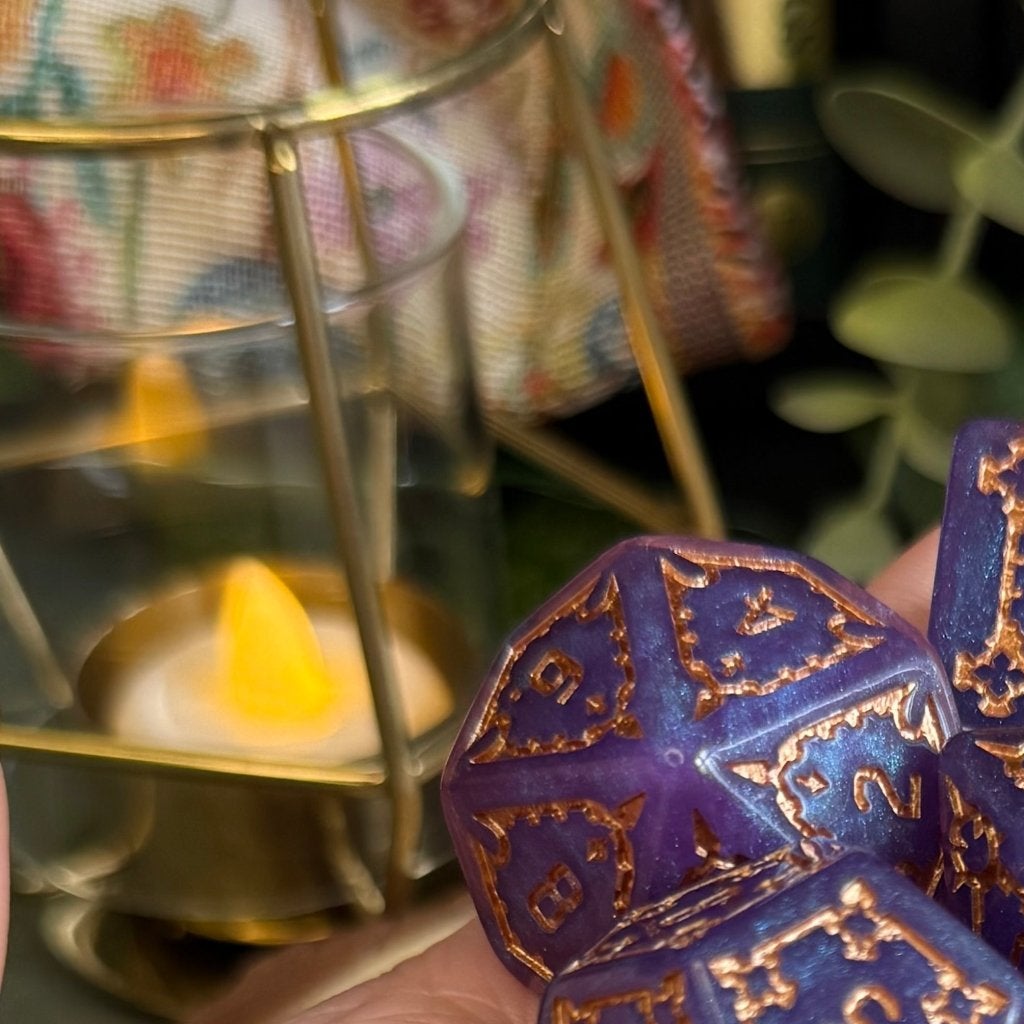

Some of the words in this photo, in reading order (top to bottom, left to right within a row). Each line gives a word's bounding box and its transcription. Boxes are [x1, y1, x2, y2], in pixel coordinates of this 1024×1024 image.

[736, 587, 797, 635] 4
[853, 765, 922, 820] 2
[528, 862, 584, 934] 8
